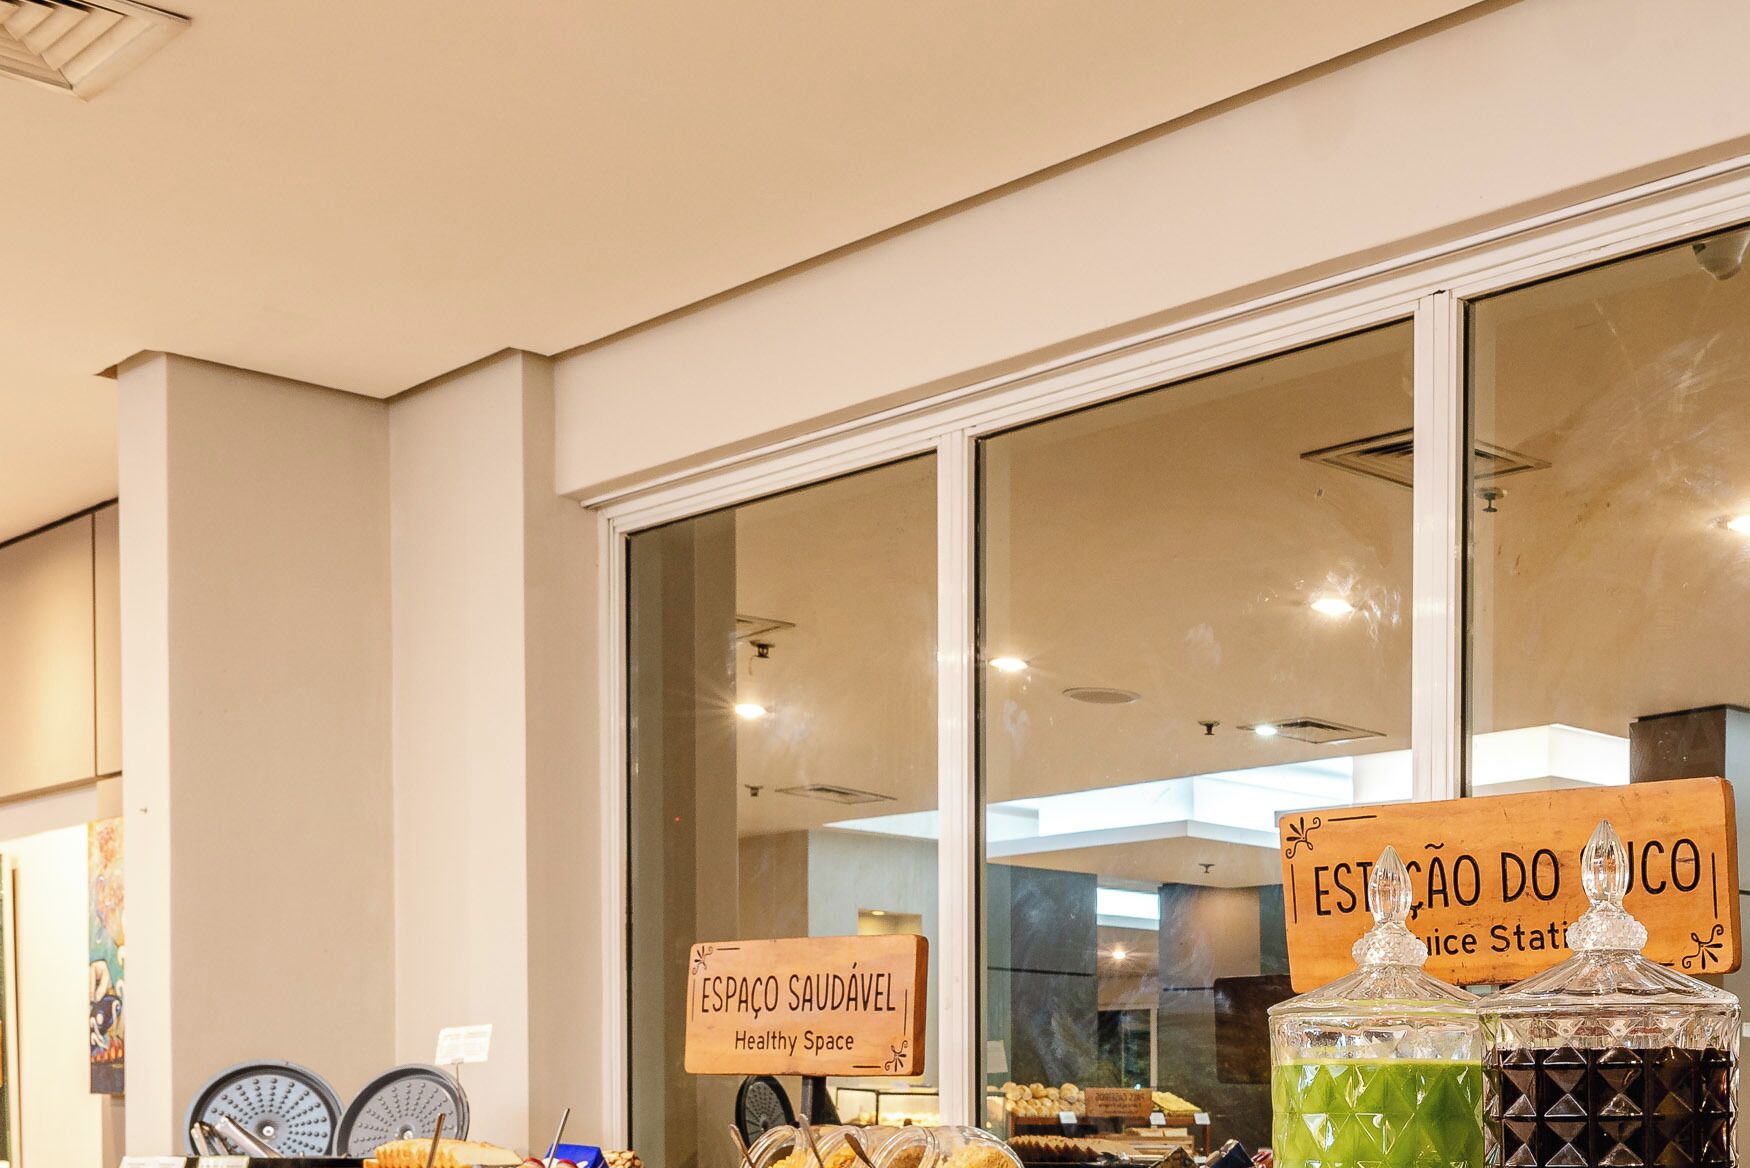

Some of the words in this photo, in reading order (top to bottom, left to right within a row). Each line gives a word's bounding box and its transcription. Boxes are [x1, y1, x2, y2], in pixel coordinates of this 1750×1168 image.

[1314, 842, 1481, 920] ESTÇÃO
[1502, 847, 1560, 902] DO
[701, 975, 779, 1019] ESPAÇO
[788, 962, 896, 1012] SAUDÁVEL
[735, 1030, 797, 1057] Healthy
[803, 1030, 854, 1056] Space
